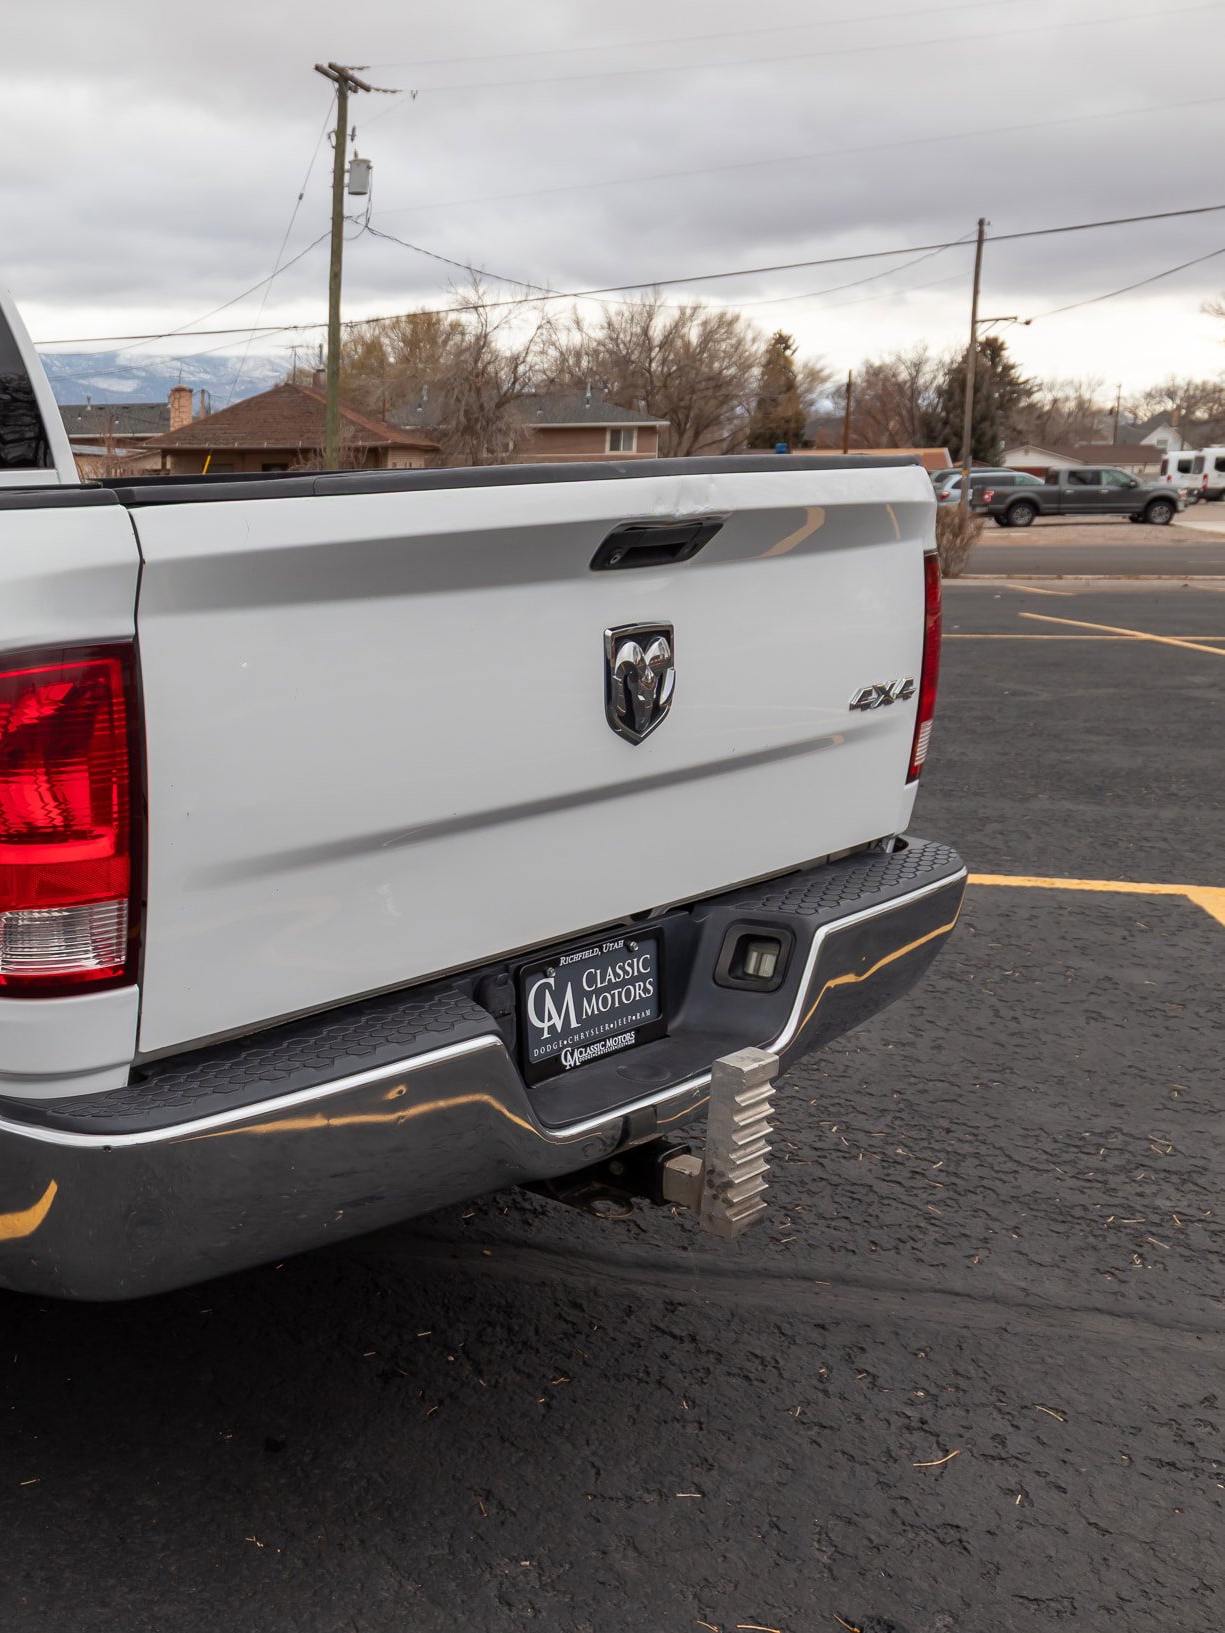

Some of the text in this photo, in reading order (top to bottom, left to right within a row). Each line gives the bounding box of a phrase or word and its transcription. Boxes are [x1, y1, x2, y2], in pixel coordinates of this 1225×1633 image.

[560, 940, 624, 966] RICHFIELD, UTAH
[583, 955, 651, 991] CLASSIC
[582, 978, 653, 1019] MOTORS
[578, 1042, 604, 1057] CLASSIC
[606, 1031, 635, 1047] MOTORS
